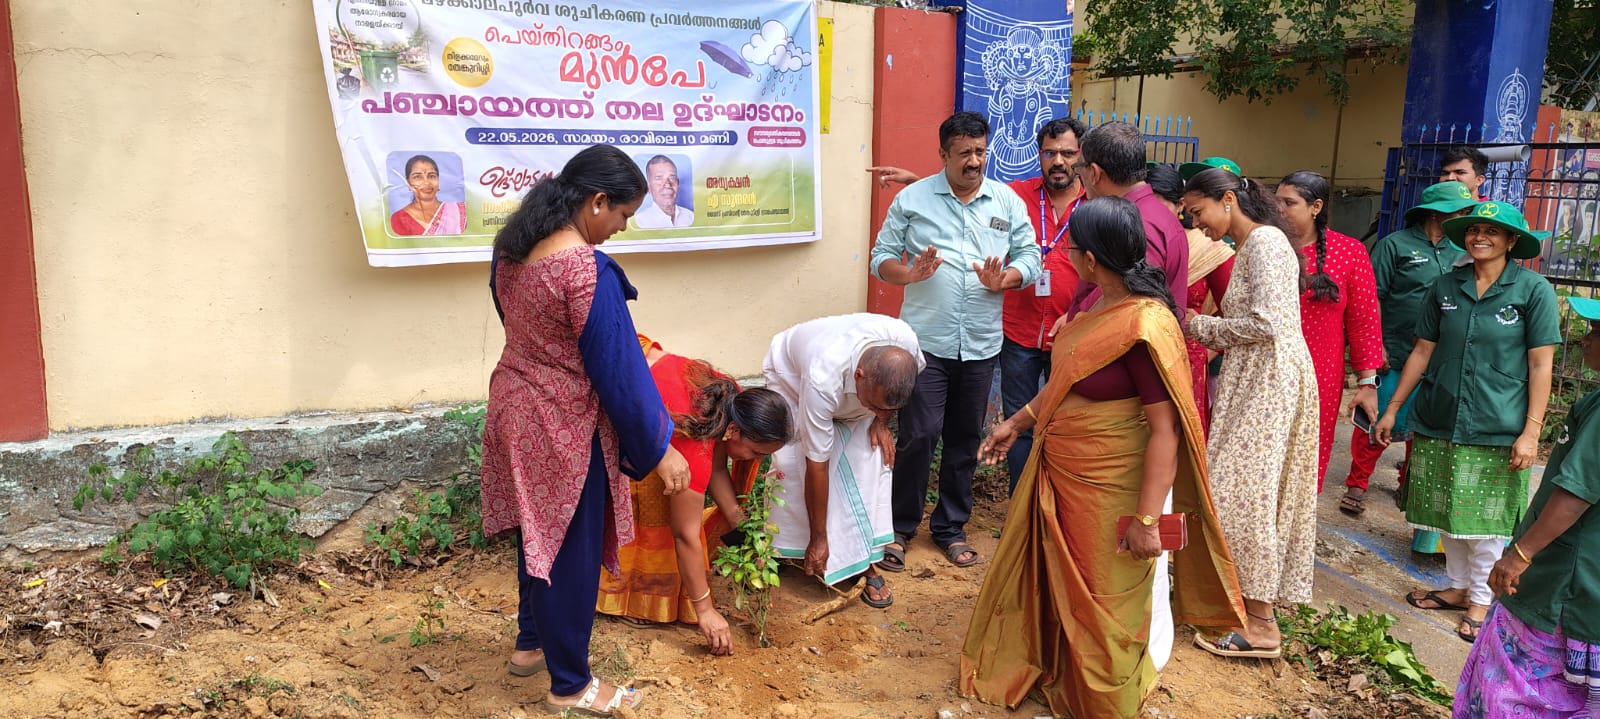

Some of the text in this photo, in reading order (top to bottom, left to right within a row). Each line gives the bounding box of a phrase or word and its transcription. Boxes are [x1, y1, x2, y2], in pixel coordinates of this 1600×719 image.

[555, 4, 646, 22] ശുചീകരണ
[650, 12, 761, 31] പ്രവർത്തനങ്ങൾ
[559, 45, 706, 90] മുൻപേ
[361, 91, 804, 127] പഞ്ചായത്ത് തല ഉദ്ഘാടനം
[478, 131, 730, 144] 22.05.2026, സമയം രാവിലെ 10 മണി
